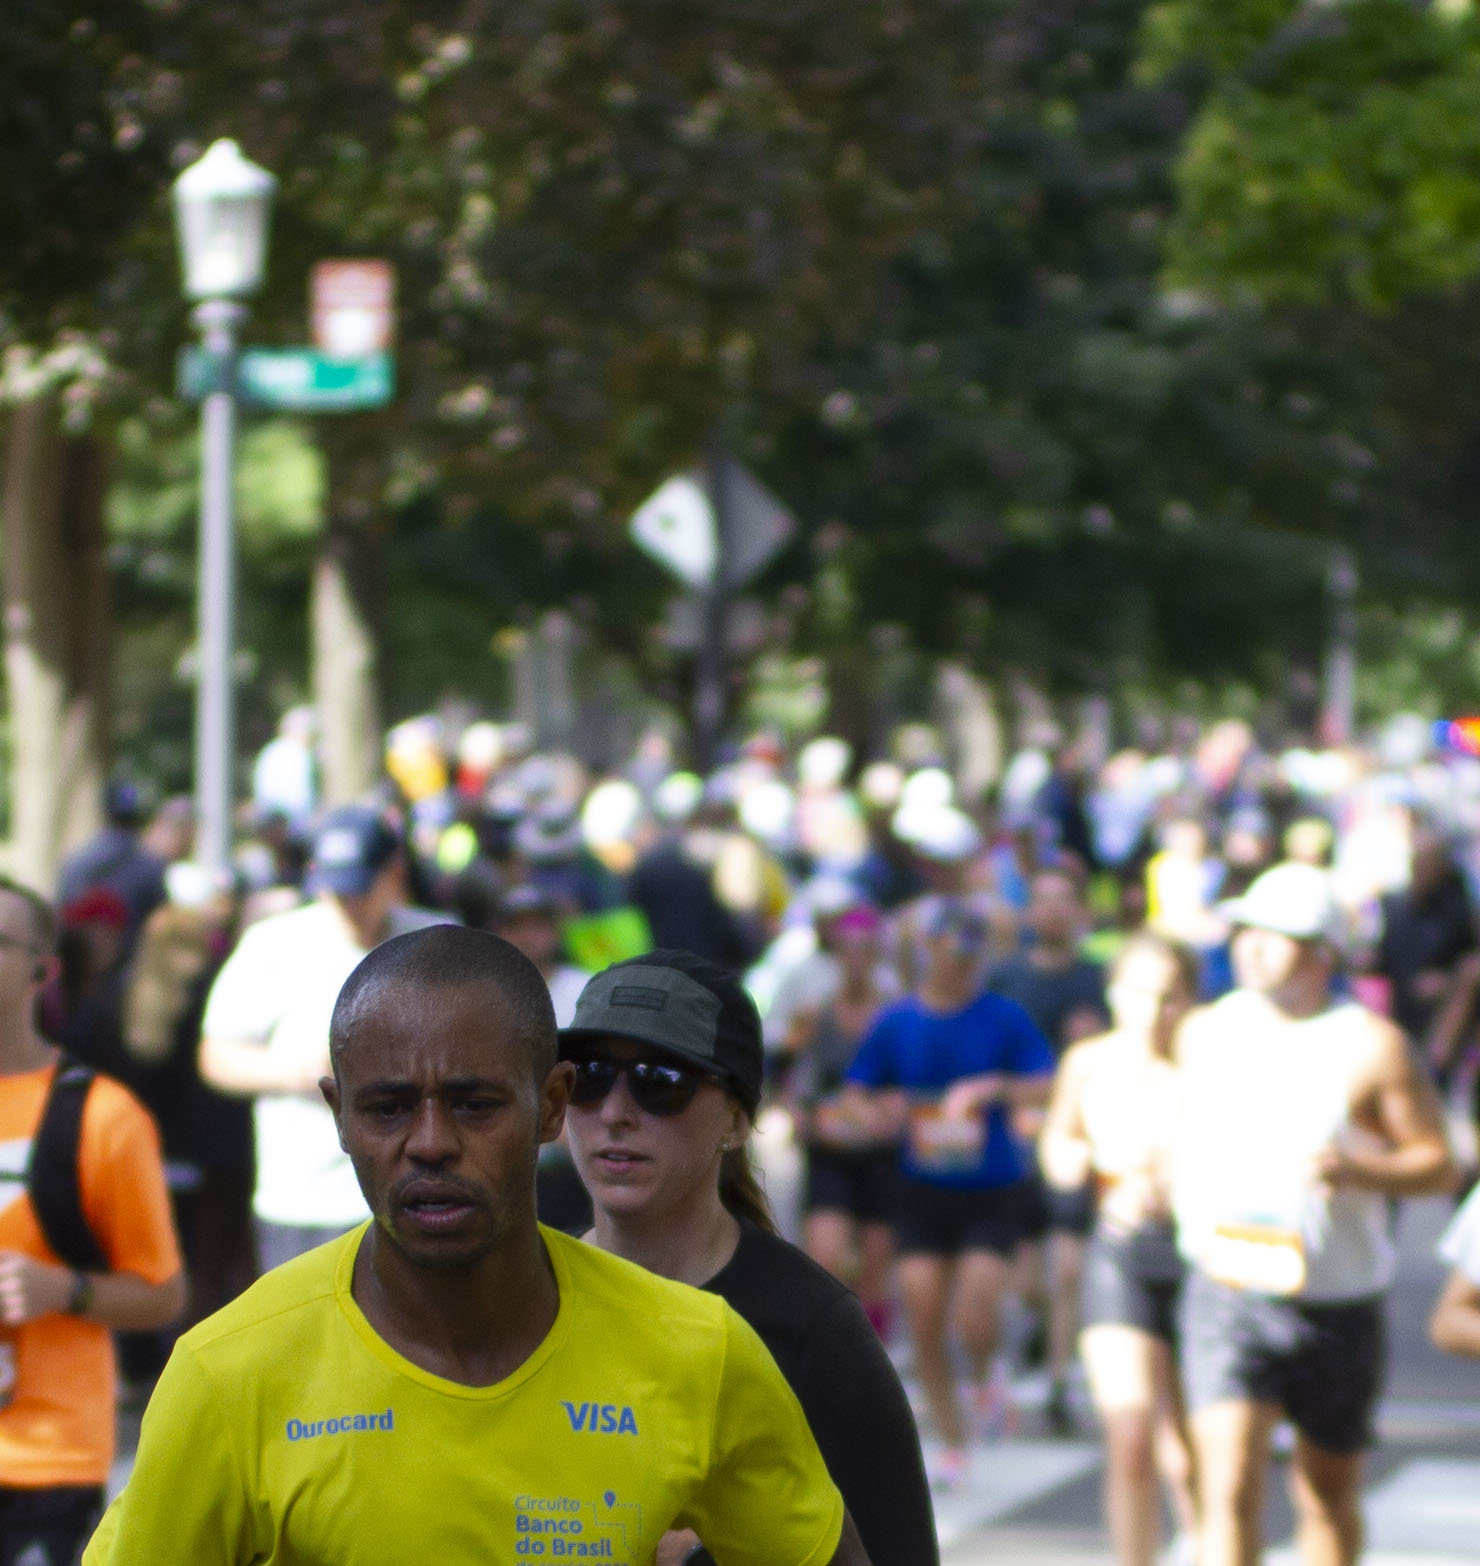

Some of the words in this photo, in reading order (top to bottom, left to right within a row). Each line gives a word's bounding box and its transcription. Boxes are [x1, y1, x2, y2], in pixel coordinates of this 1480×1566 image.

[286, 1408, 394, 1441] Ourocard
[559, 1400, 639, 1436] VISA
[515, 1495, 581, 1512] Circuito
[516, 1514, 583, 1534] Banco
[515, 1535, 546, 1555] do
[552, 1538, 612, 1557] Brasil
